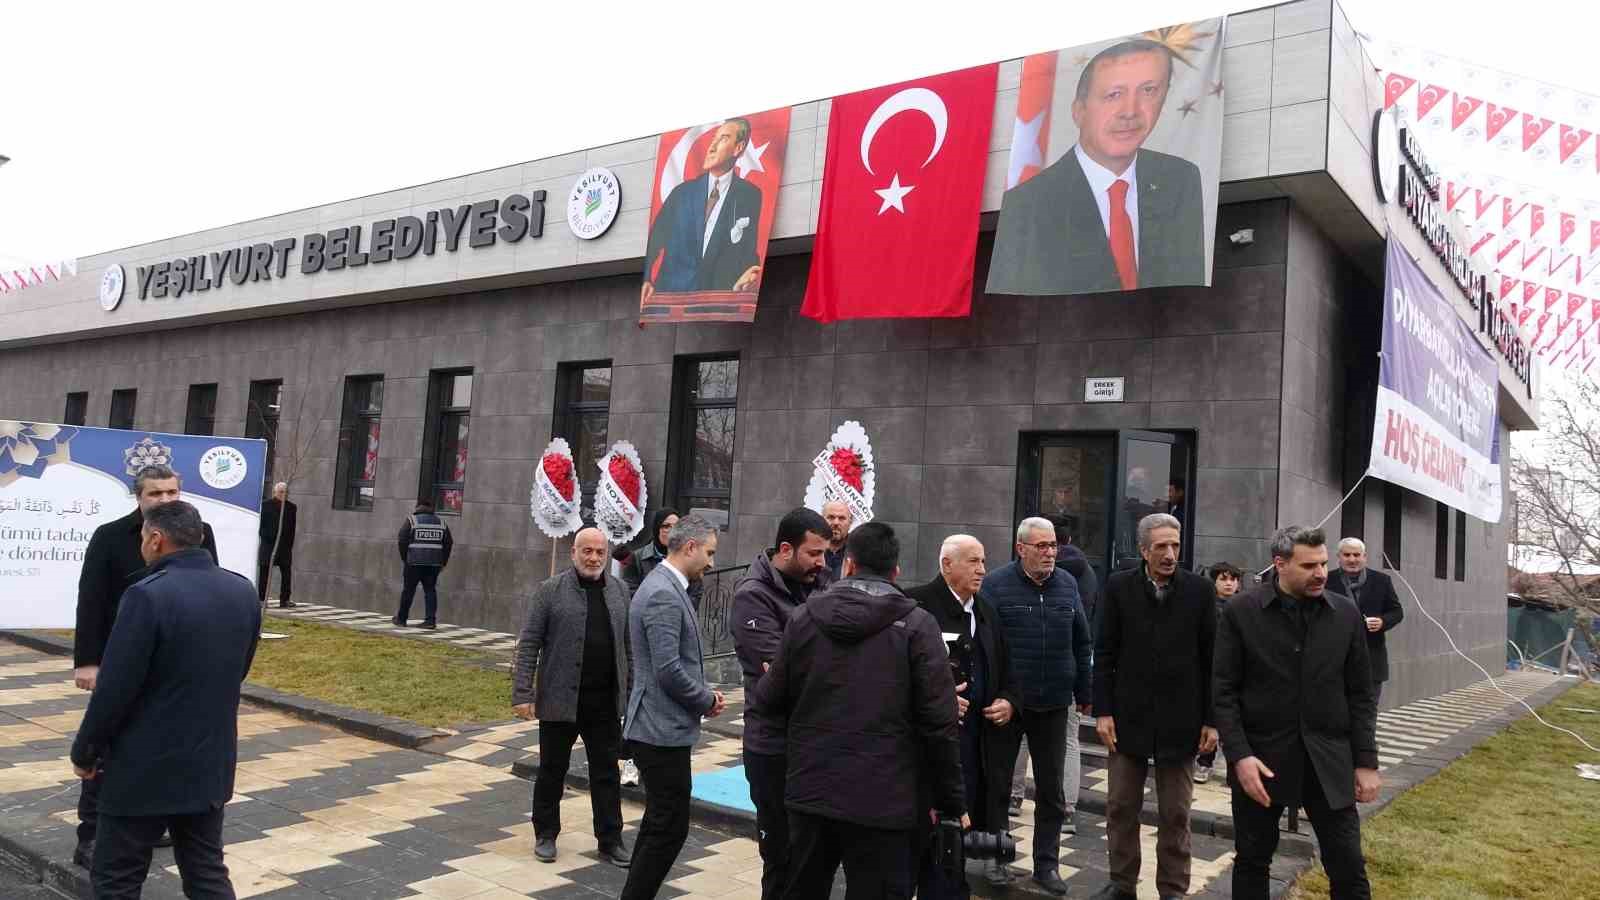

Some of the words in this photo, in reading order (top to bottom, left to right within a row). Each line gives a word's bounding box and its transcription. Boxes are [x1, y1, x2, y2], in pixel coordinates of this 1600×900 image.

[136, 237, 297, 301] YEŞİLYURT
[301, 189, 547, 275] BELEDİYESİ
[1383, 409, 1419, 474] HOŞ
[0, 526, 42, 541] ümü
[47, 527, 92, 542] tadac
[8, 543, 85, 561] döndürü
